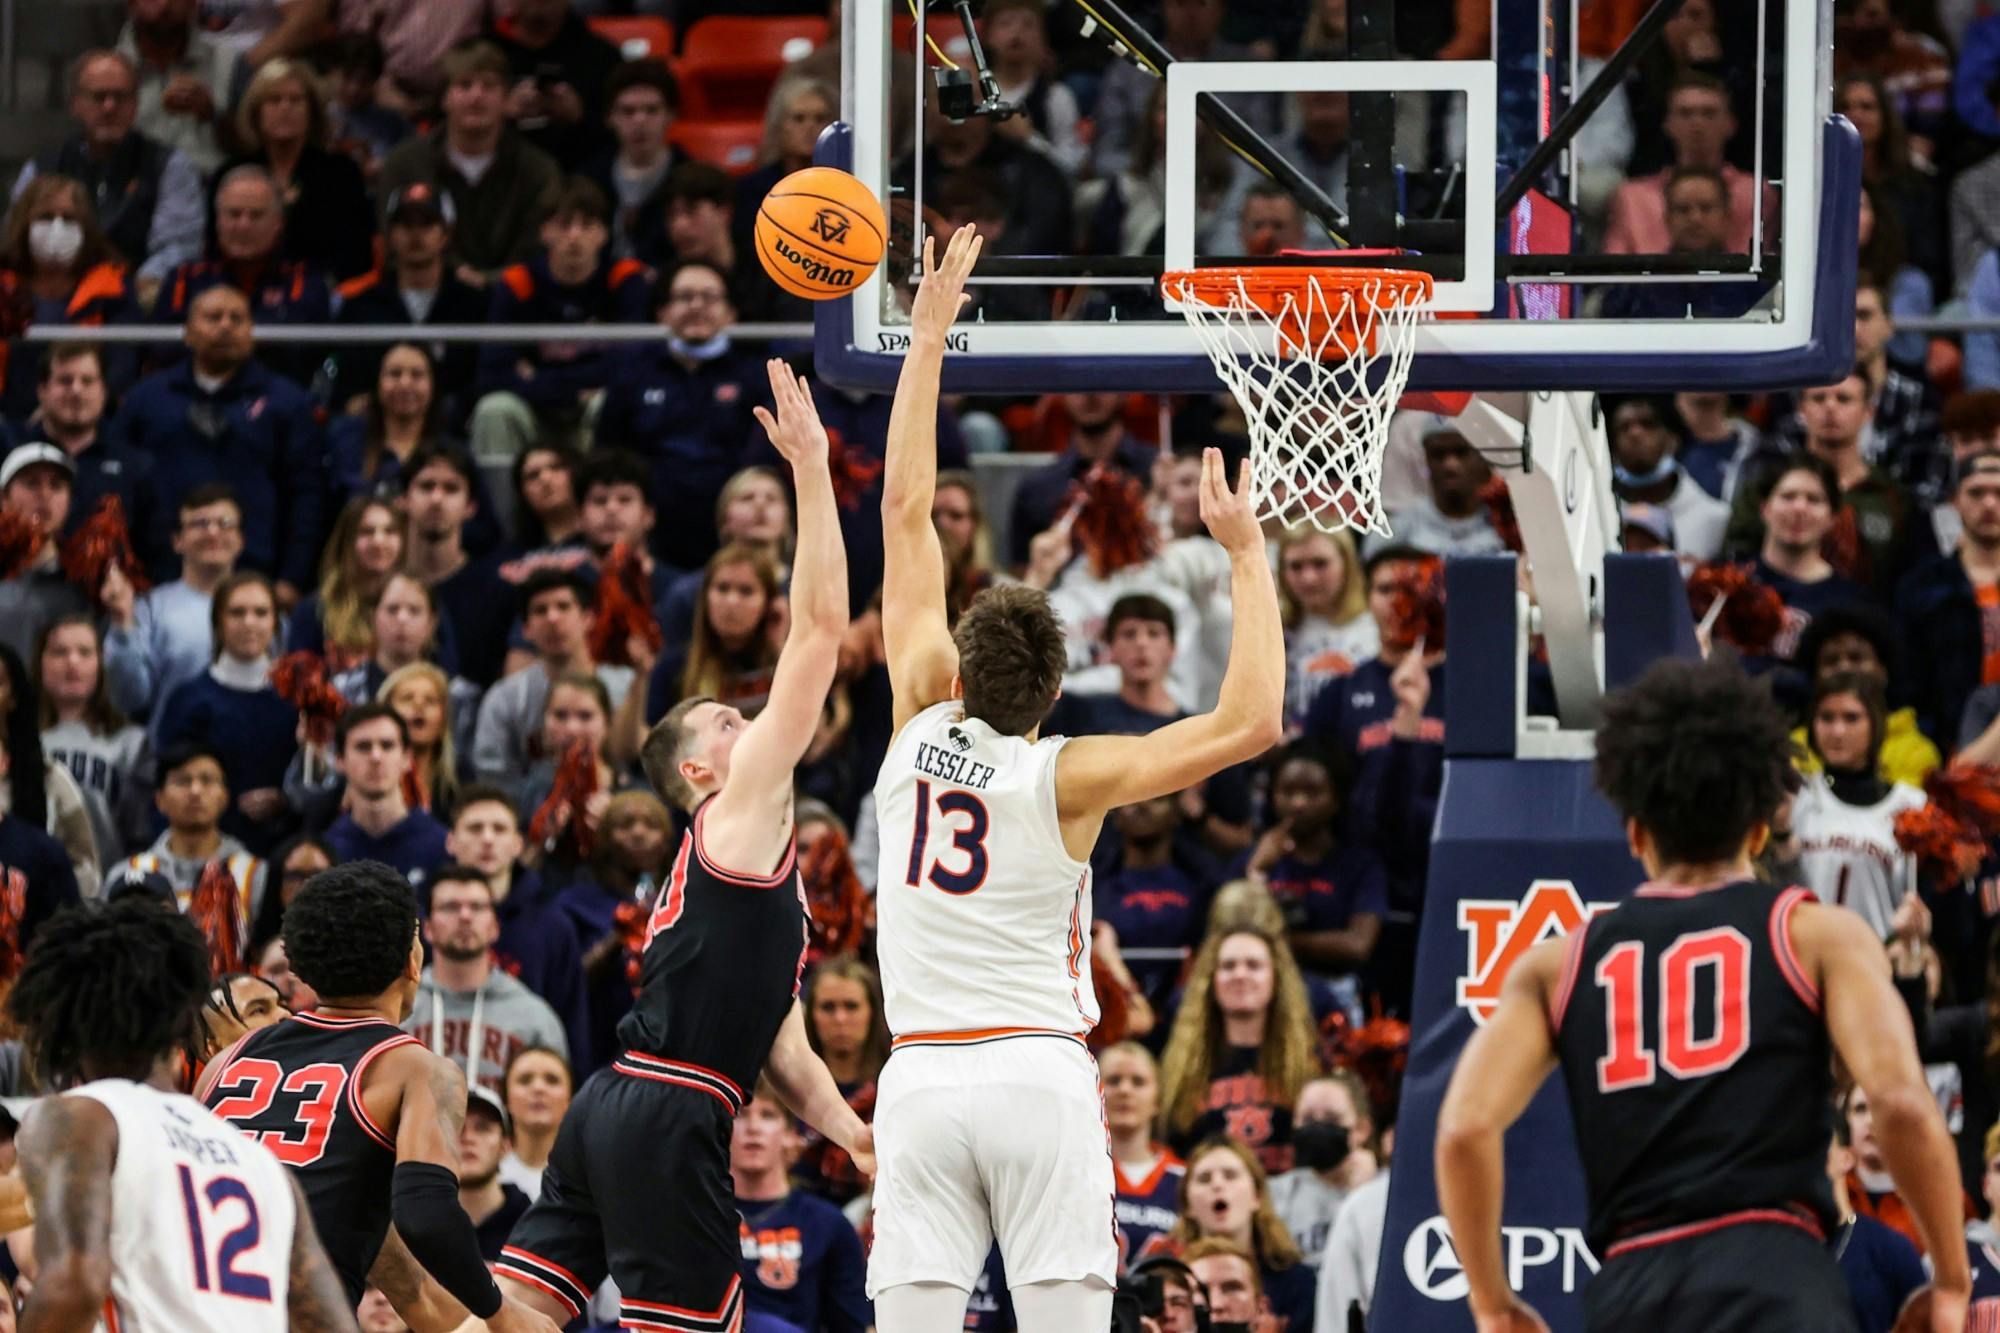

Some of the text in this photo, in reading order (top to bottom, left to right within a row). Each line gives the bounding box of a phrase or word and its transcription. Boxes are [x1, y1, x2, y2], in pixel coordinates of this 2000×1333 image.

[775, 237, 855, 286] Wilson
[876, 331, 969, 353] SPANG
[914, 741, 996, 790] KESSLER
[905, 778, 990, 896] 13
[1594, 924, 1752, 1095] 10
[210, 1056, 349, 1167] 23
[175, 1161, 273, 1304] 12
